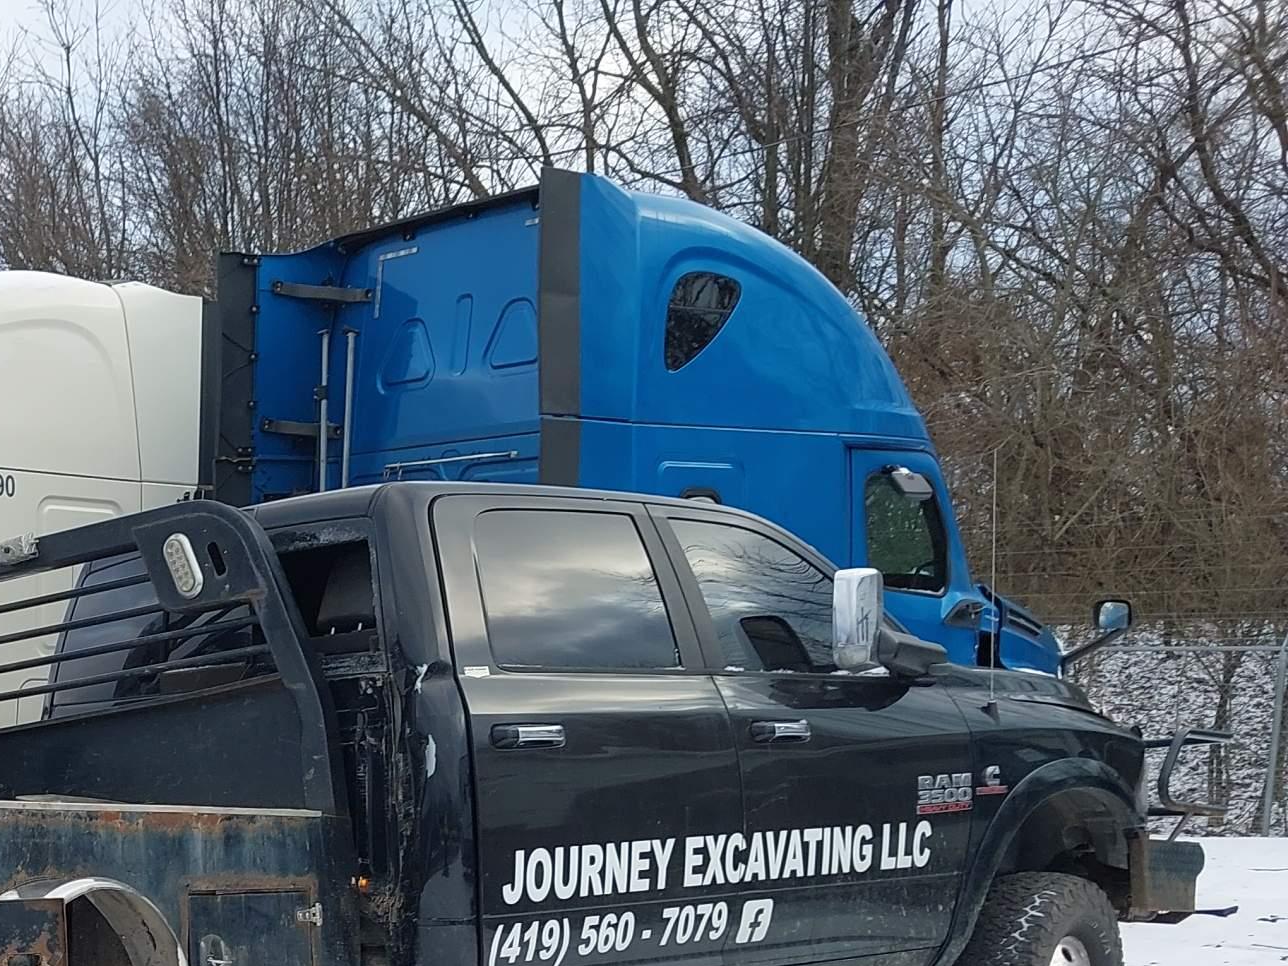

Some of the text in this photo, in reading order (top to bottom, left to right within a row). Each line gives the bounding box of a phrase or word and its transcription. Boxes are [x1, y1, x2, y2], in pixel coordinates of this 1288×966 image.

[917, 772, 972, 790] RAM
[917, 787, 972, 805] 3500
[502, 820, 932, 905] JOURNEY EXCAVATING LLC
[578, 911, 636, 957] 560
[658, 901, 729, 946] 7079
